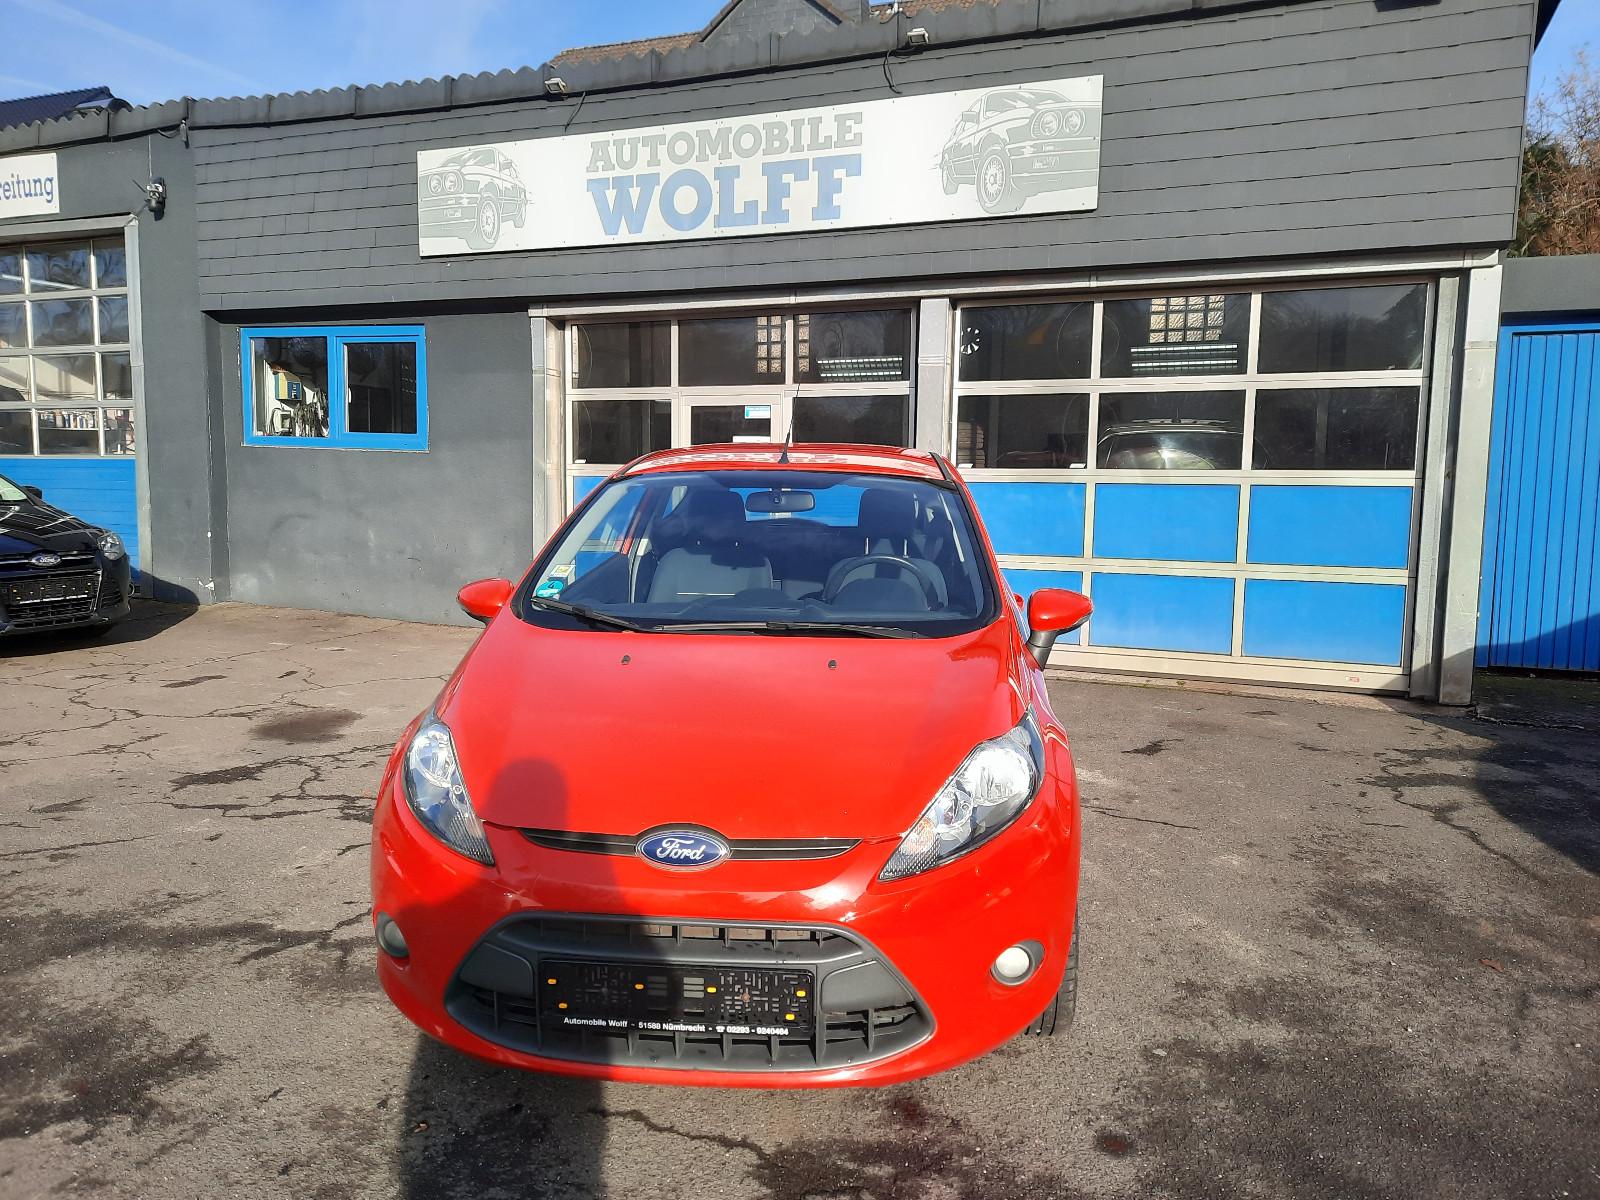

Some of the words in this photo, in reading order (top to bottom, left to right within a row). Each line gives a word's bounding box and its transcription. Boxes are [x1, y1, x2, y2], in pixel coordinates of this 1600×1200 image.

[586, 111, 863, 173] AUTOMOBILE
[586, 153, 862, 236] WOLFF
[656, 838, 705, 860] Ford
[563, 1017, 606, 1026] Automobile
